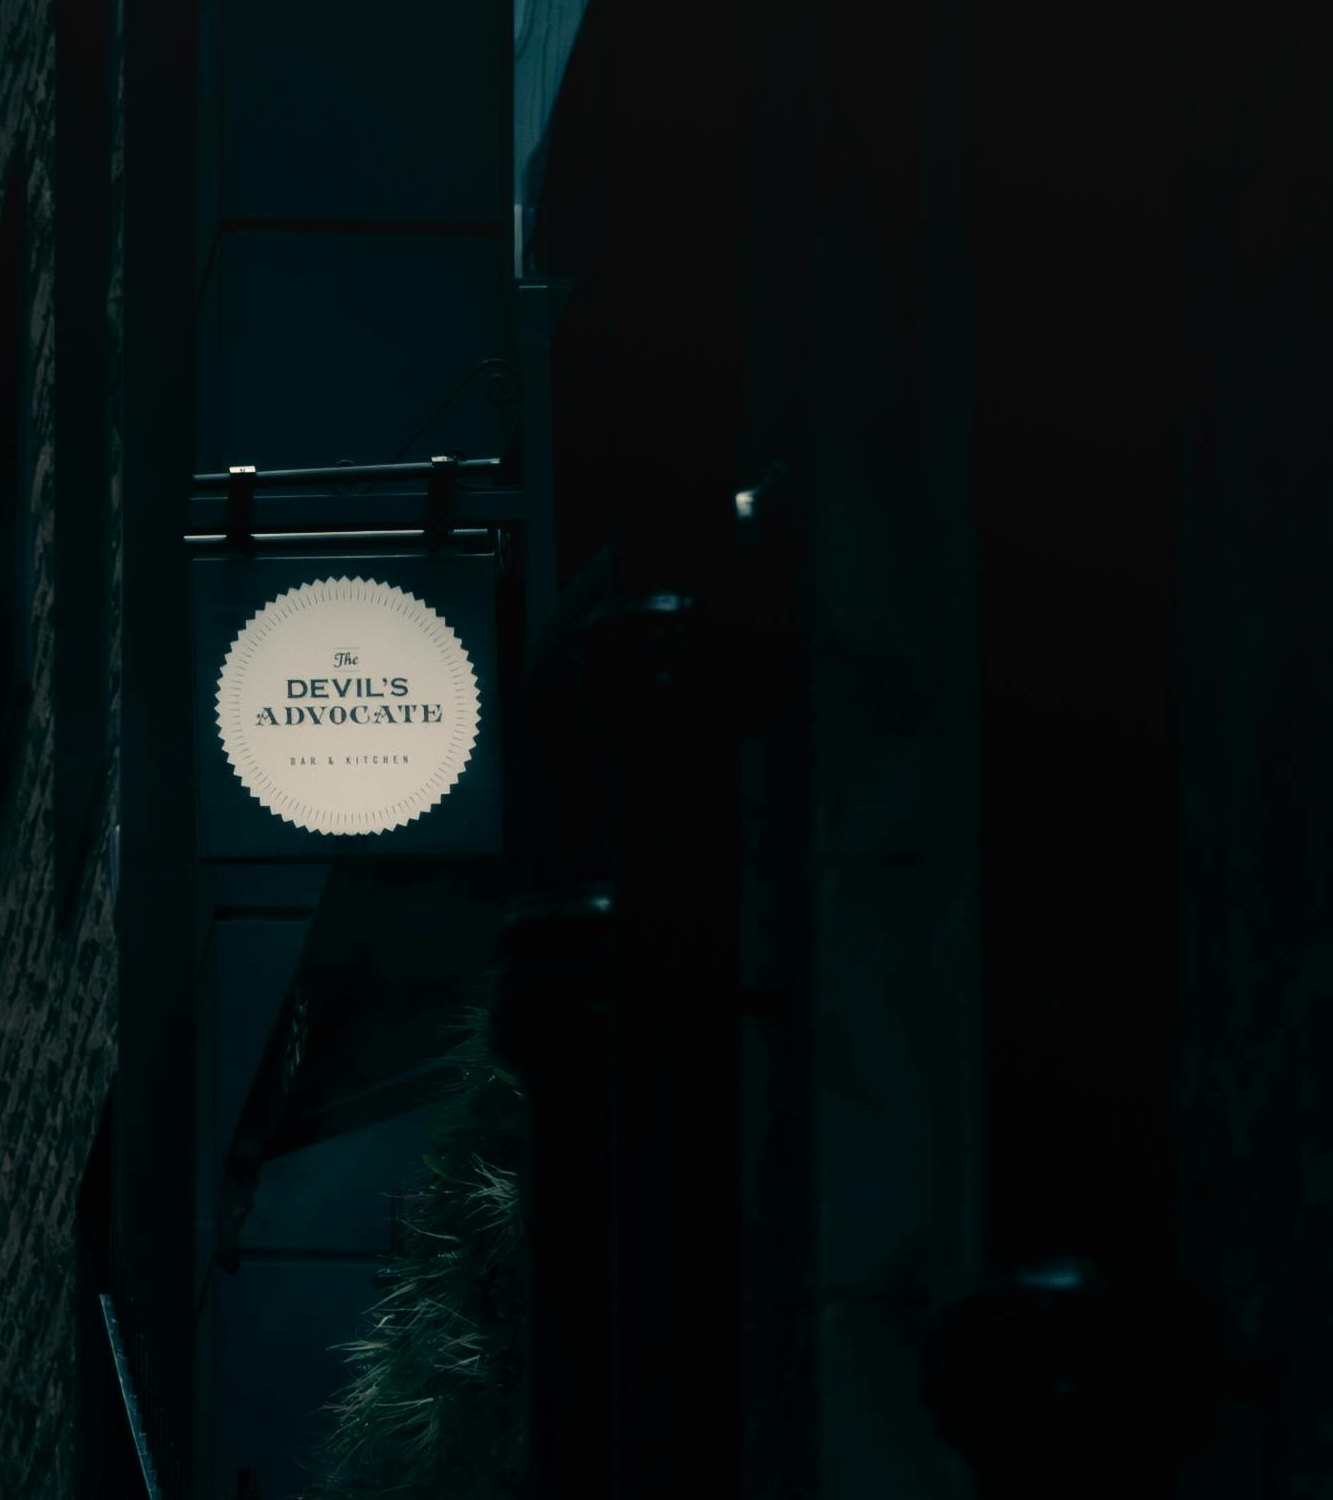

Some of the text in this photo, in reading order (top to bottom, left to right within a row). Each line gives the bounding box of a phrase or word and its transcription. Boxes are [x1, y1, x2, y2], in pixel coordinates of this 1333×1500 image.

[333, 652, 359, 668] The
[286, 677, 409, 699] DEVIL'S
[255, 703, 443, 726] ADVOCATE
[289, 755, 317, 766] BAR
[345, 754, 410, 765] KITCHEN
